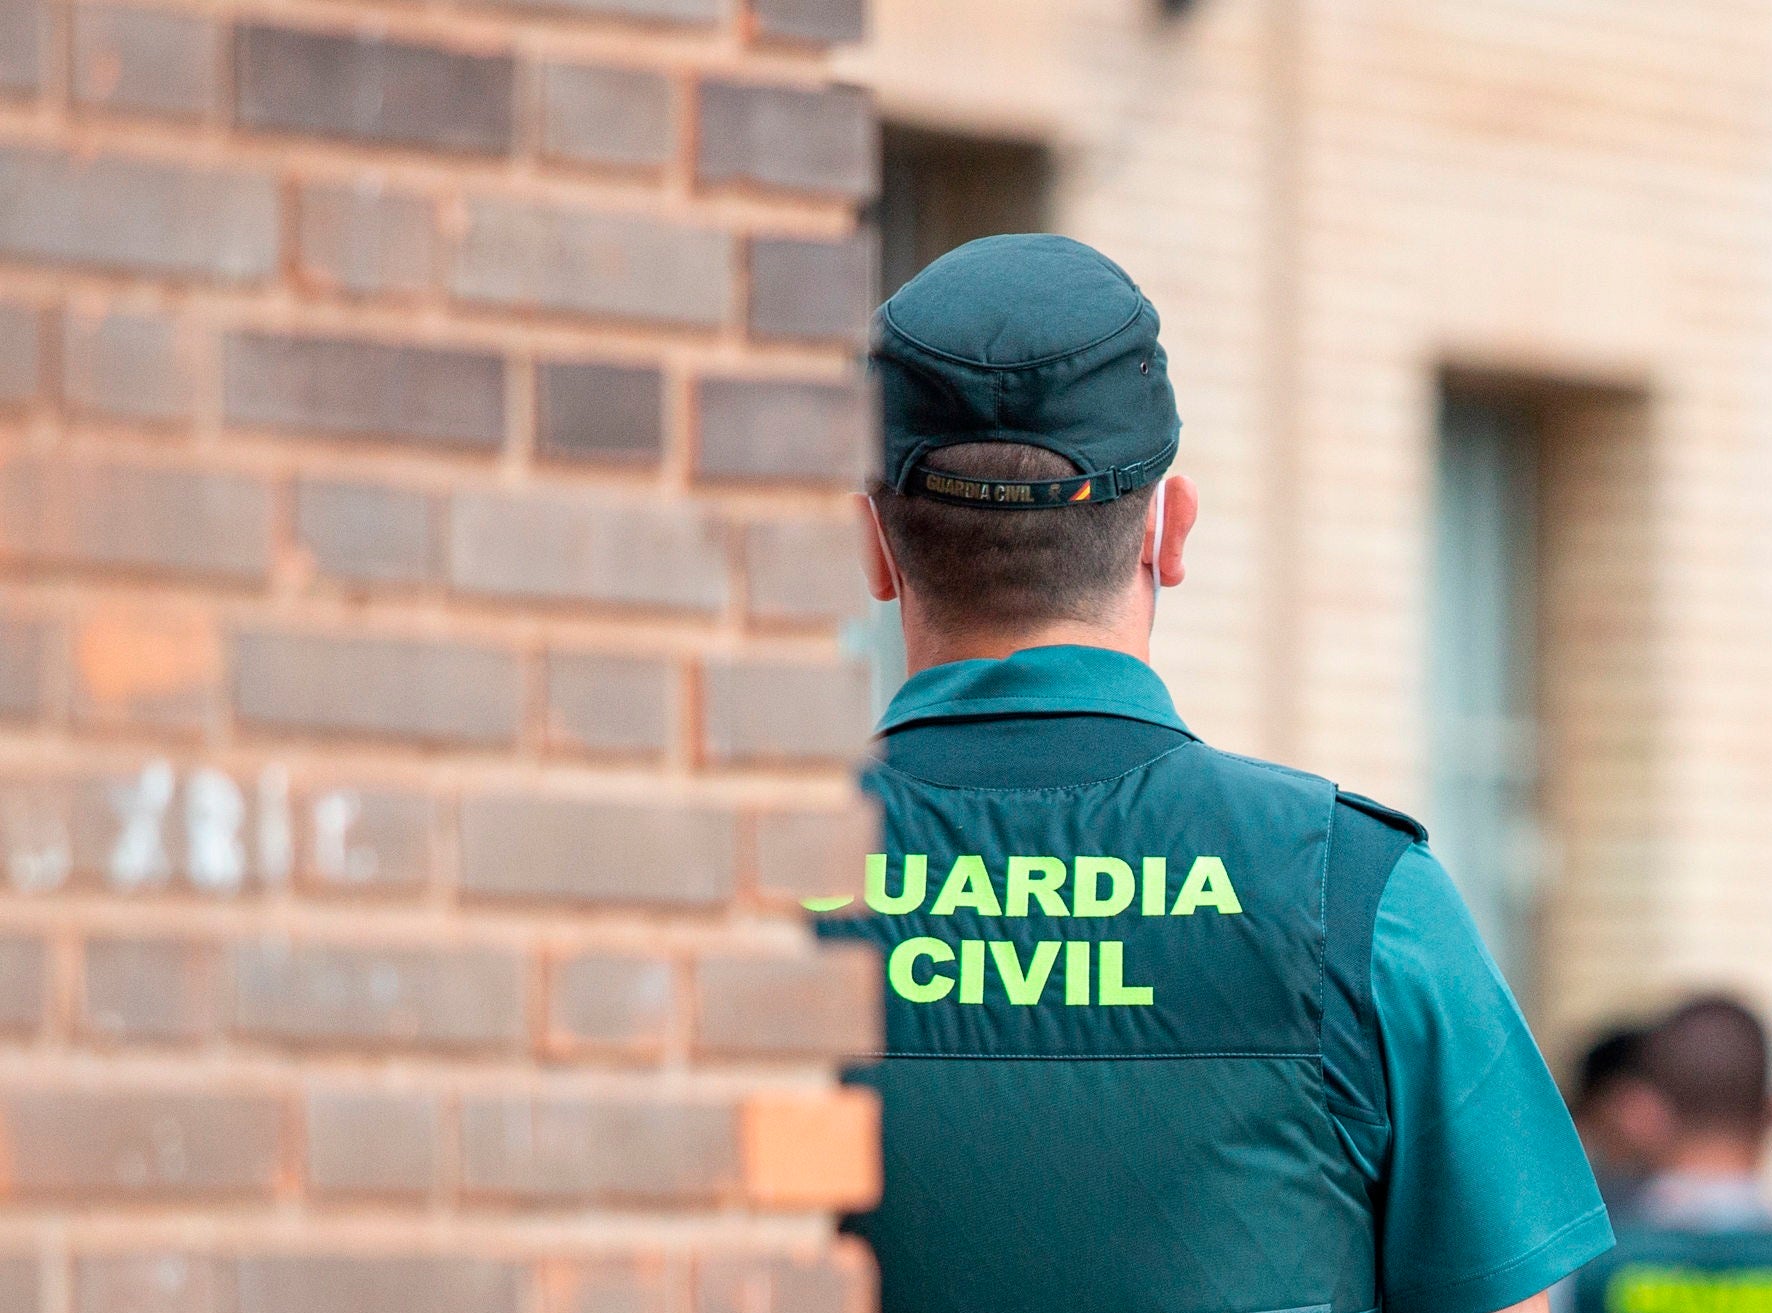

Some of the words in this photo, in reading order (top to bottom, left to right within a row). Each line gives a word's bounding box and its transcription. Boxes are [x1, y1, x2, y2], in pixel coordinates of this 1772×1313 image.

[926, 475, 991, 500] GUARDIA
[994, 484, 1035, 502] CIVIL
[801, 854, 1242, 917] UARDIA
[889, 937, 1153, 1005] CIVIL
